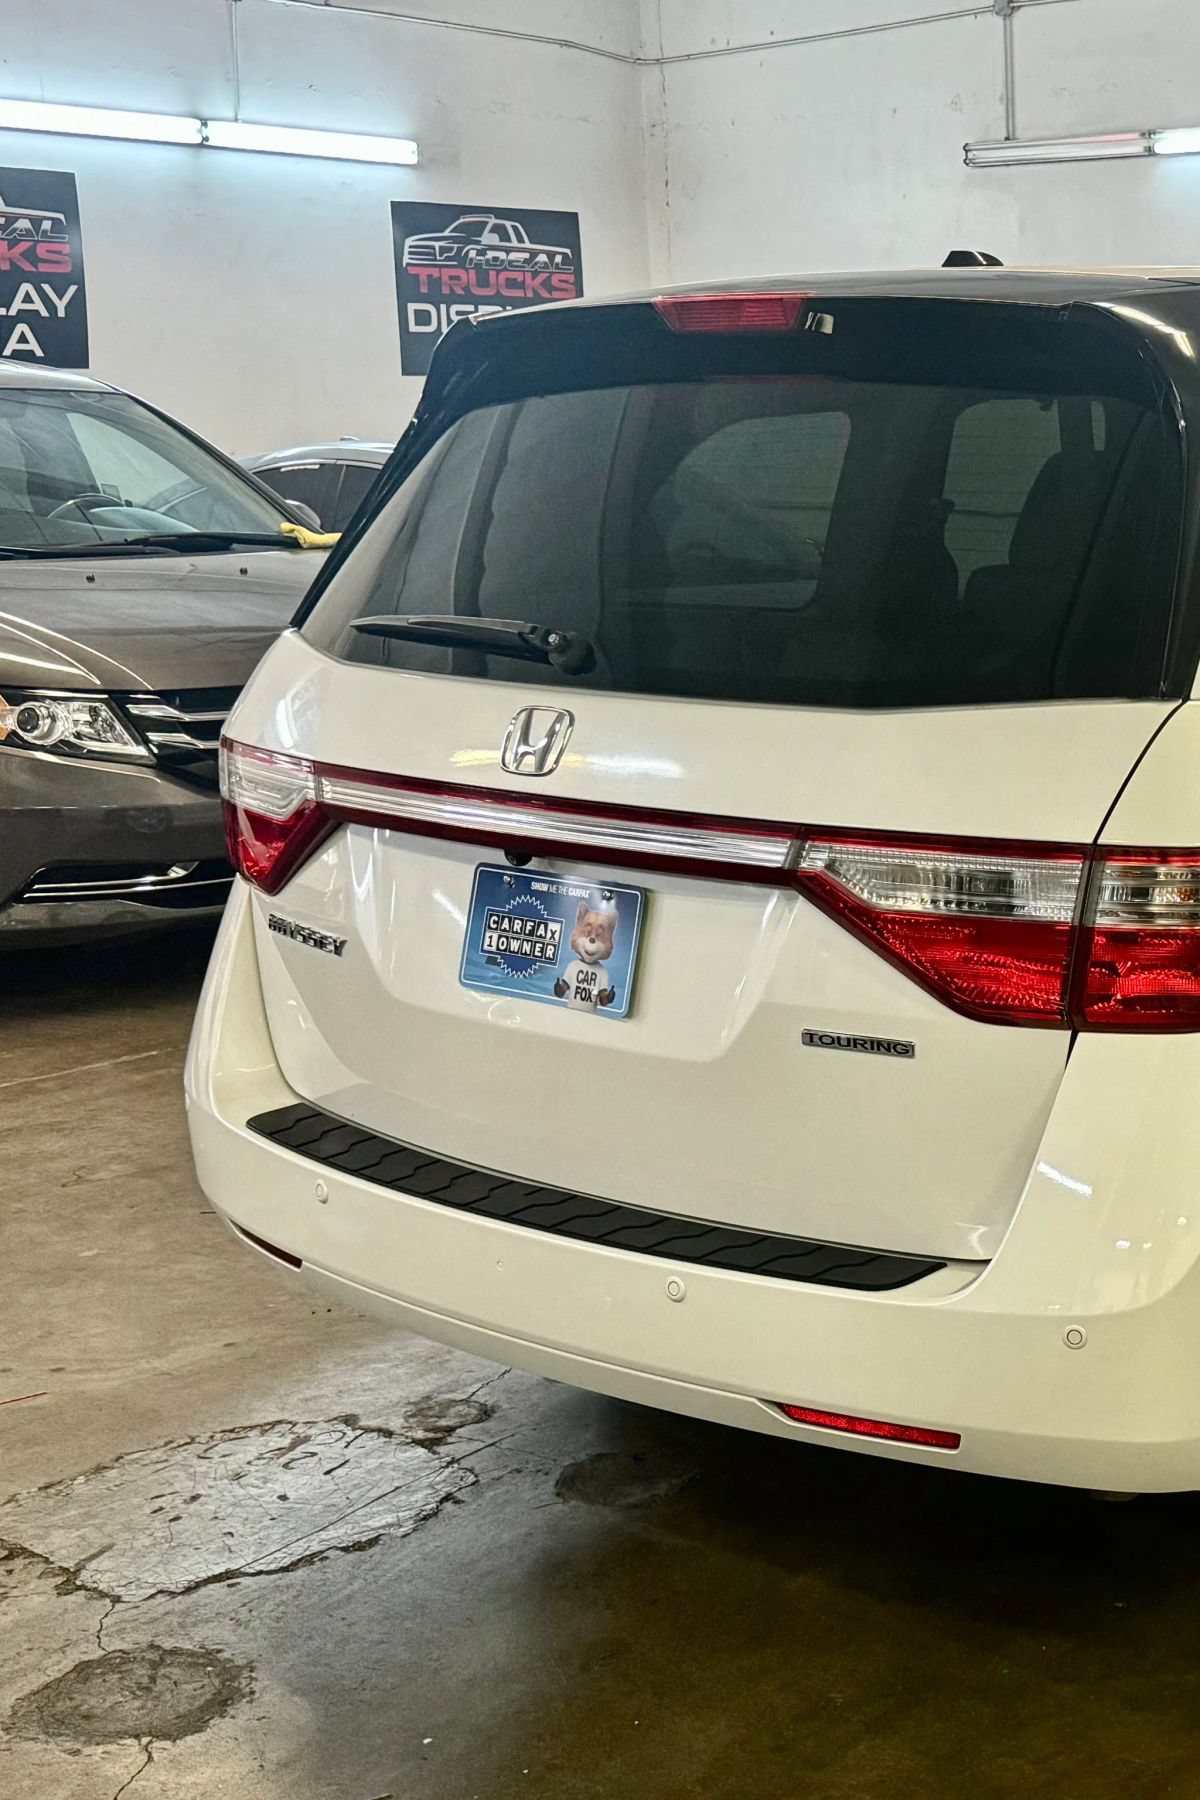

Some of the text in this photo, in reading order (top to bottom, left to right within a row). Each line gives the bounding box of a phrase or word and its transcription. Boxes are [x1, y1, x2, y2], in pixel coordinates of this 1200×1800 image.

[466, 250, 574, 273] I-DEAL
[407, 267, 577, 299] TRUCKS
[531, 881, 590, 899] SHOW ME THE CARFAX
[489, 915, 558, 942] CARFAX
[576, 969, 598, 987] CAR
[573, 985, 593, 1003] FOX
[805, 1032, 910, 1055] TOURING
